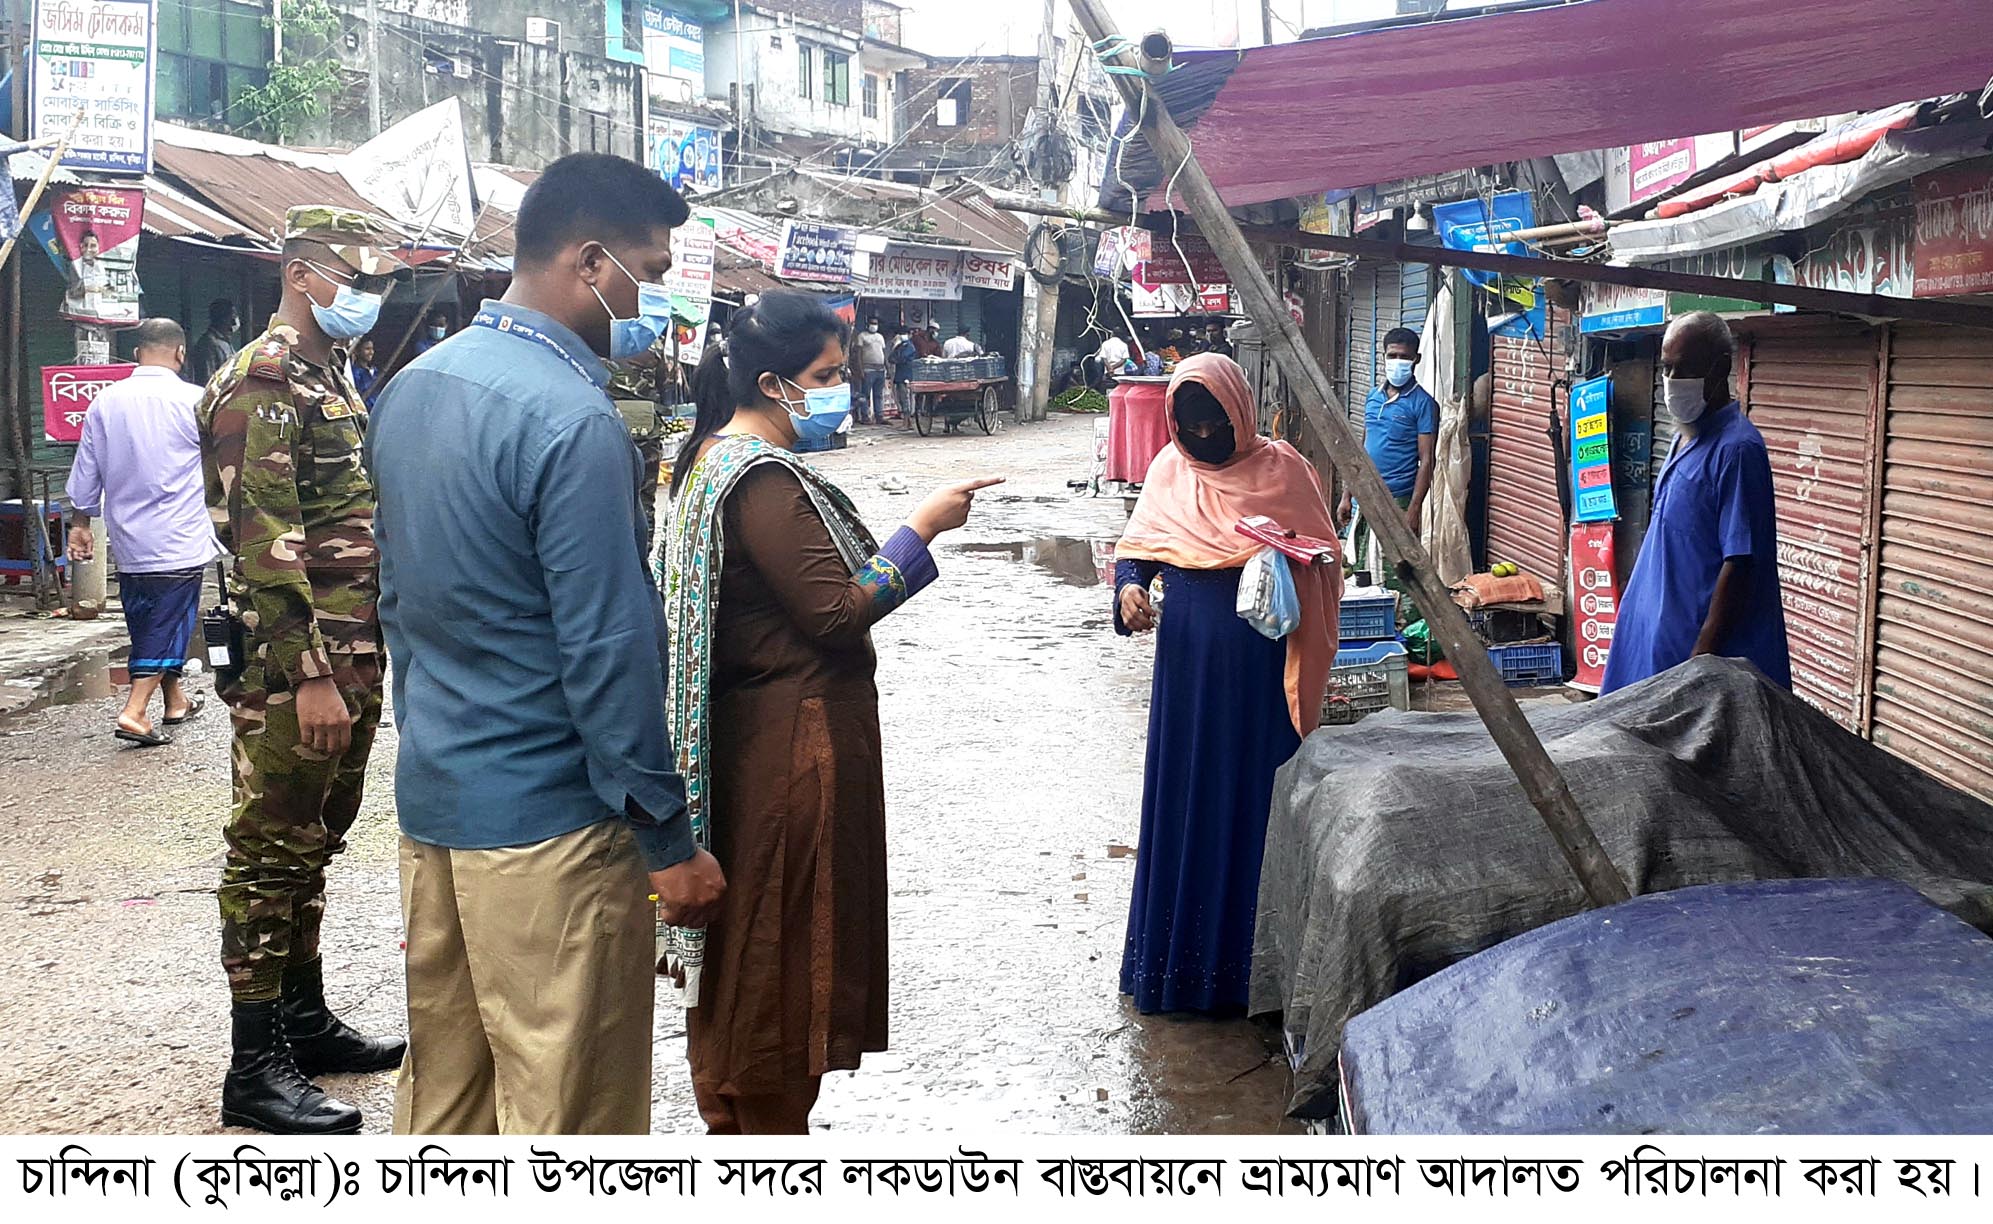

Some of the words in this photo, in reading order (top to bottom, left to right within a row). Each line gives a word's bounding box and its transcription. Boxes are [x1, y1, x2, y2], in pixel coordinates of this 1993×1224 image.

[42, 1, 83, 34] জসিম
[63, 200, 97, 215] বিকাশ
[98, 205, 131, 219] করুন
[888, 250, 932, 277] মেডিকেল
[934, 258, 949, 278] হল
[965, 252, 1012, 279] ঔষধ
[49, 372, 116, 402] বিক
